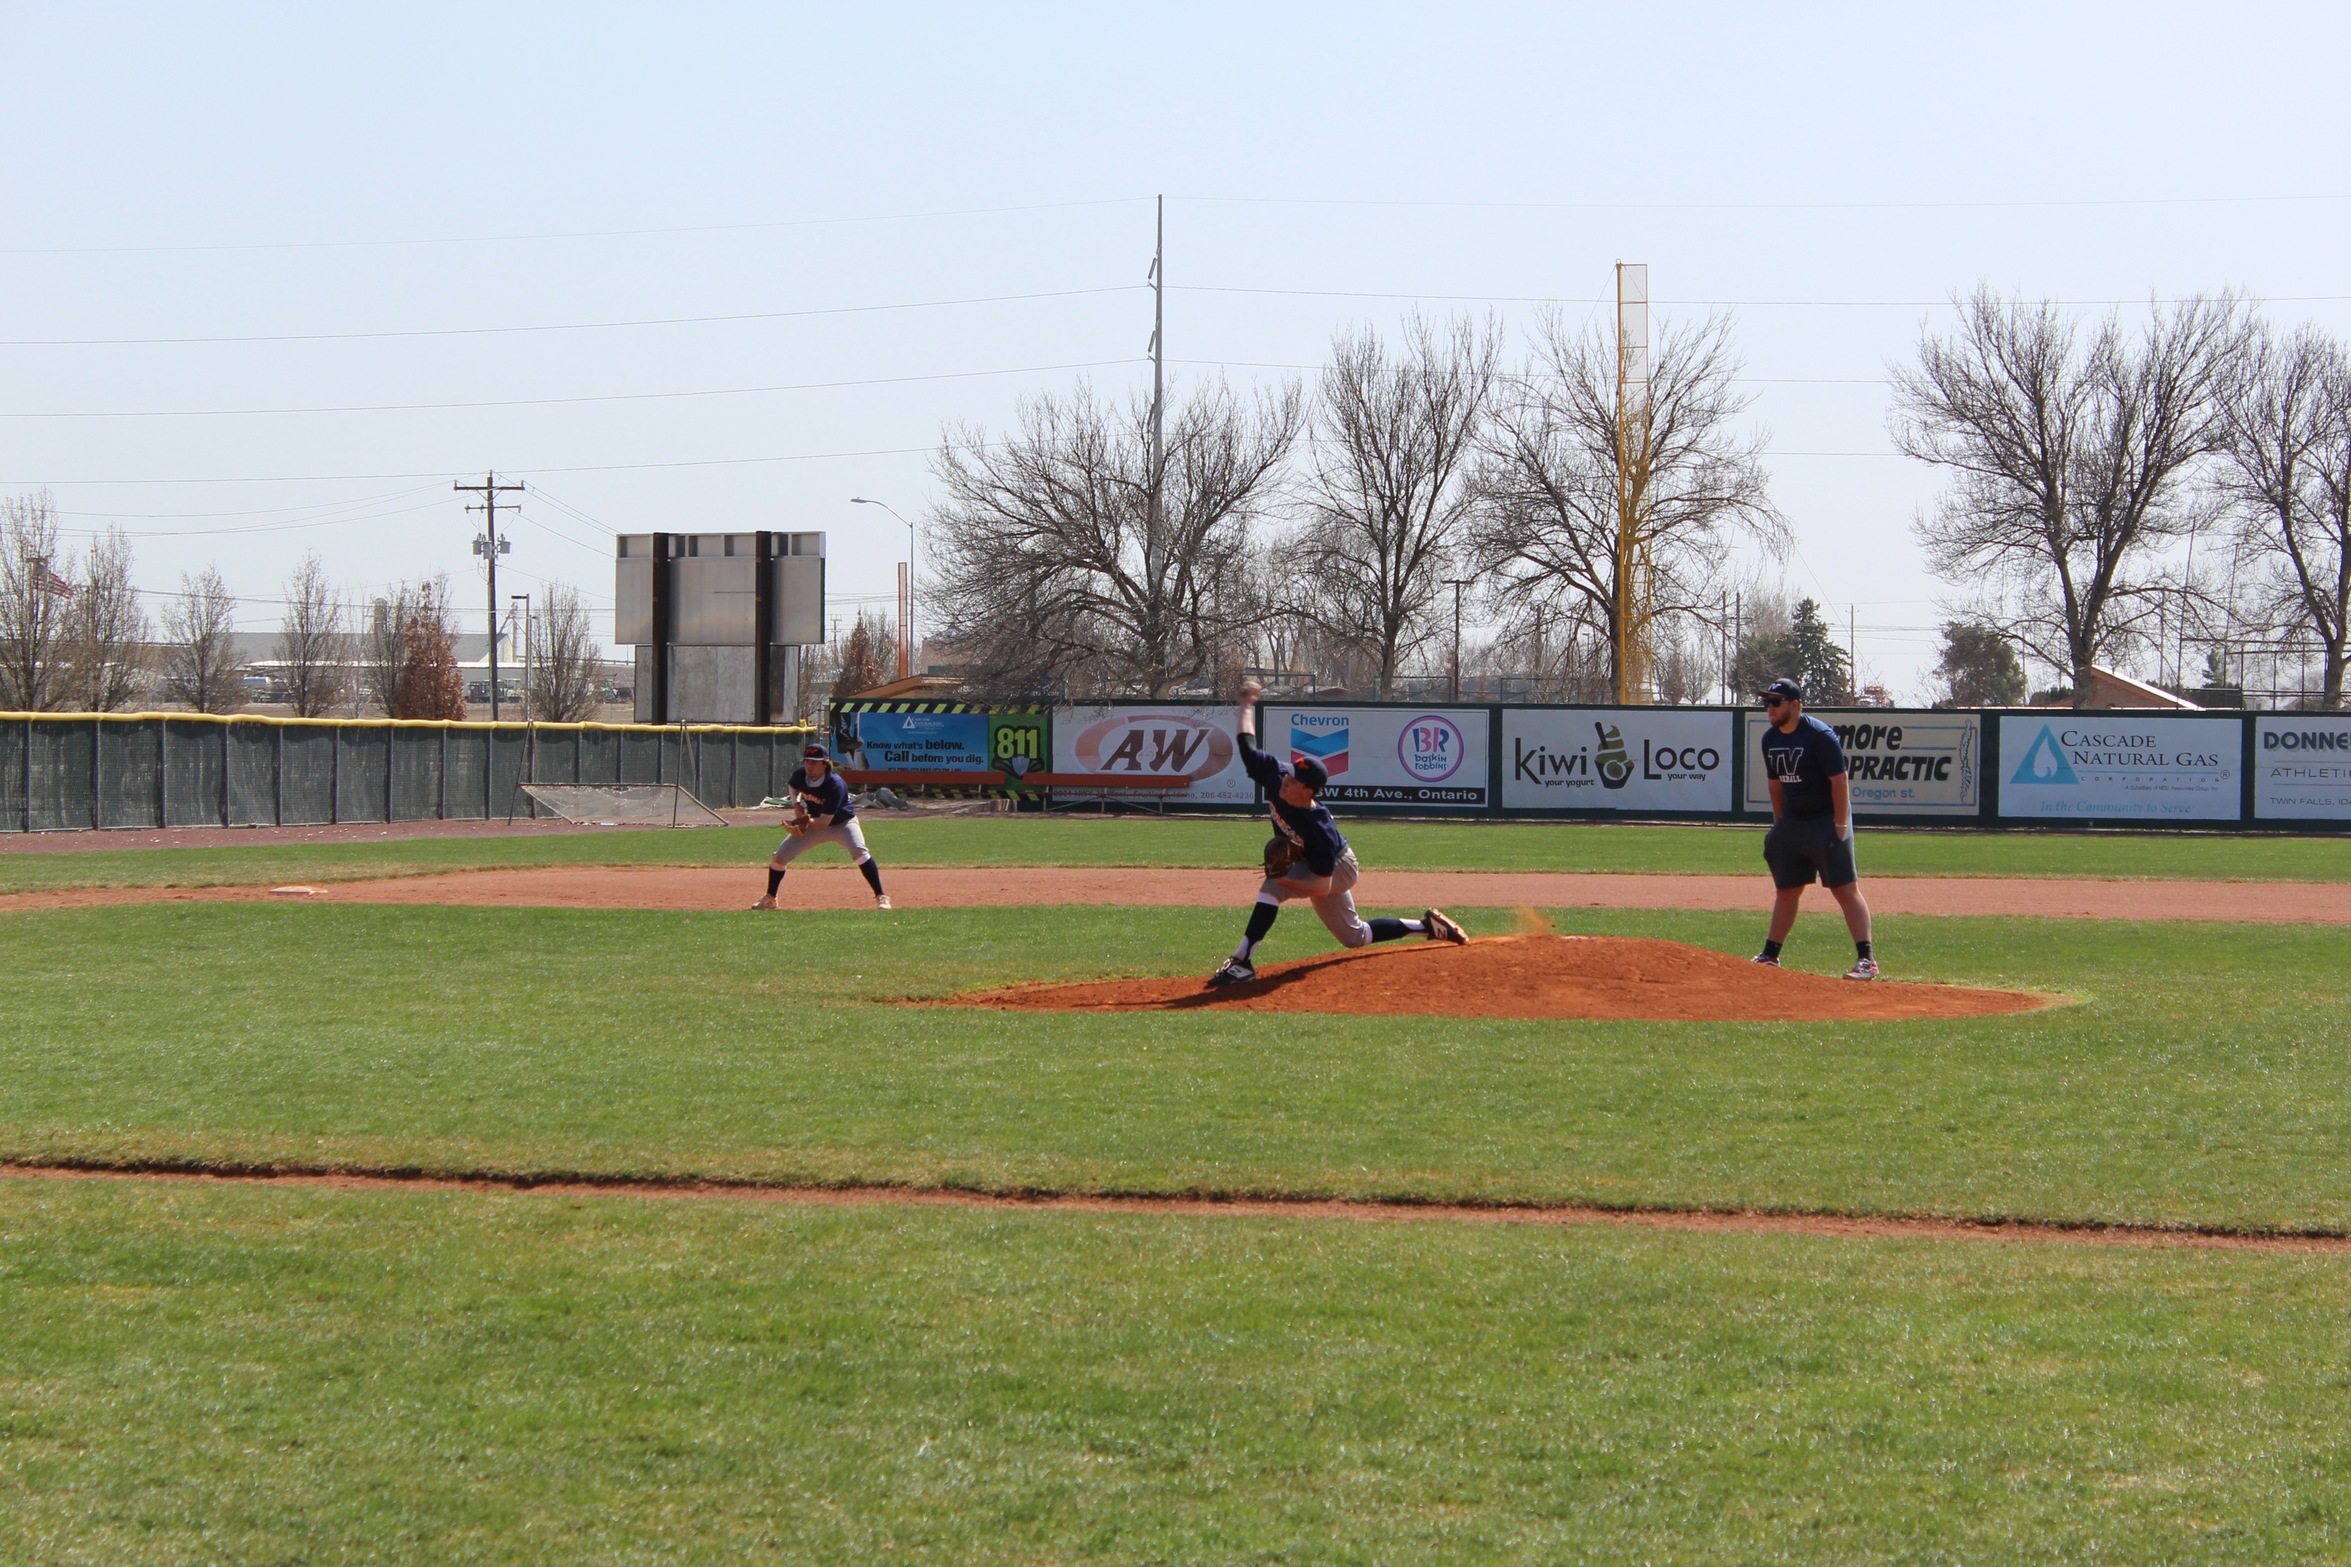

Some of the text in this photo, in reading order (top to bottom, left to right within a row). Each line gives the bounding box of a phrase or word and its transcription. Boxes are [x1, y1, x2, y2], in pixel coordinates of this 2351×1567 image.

[1291, 714, 1349, 726] Chevron
[867, 740, 964, 750] Know what's below.
[997, 728, 1038, 759] 811
[1412, 727, 1450, 753] BR
[2061, 730, 2157, 748] CASCADE
[2263, 732, 2351, 751] DONNE
[884, 750, 984, 765] Call before you dig.
[1415, 754, 1448, 763] baskin
[1768, 747, 1804, 776] TV
[2073, 751, 2219, 767] NATURAL GAS
[1415, 761, 1448, 771] robbins
[1667, 773, 1707, 781] your way
[2271, 768, 2351, 778] ATHLETI
[1545, 779, 1595, 788] your yogurt
[1344, 788, 1369, 798] 4th
[1374, 788, 1412, 800] Ave.,
[1418, 789, 1478, 800] Ontario
[1852, 786, 1915, 800] Oregon st.
[2270, 797, 2297, 805] TWIN
[2040, 801, 2192, 814] In the Community to Serve
